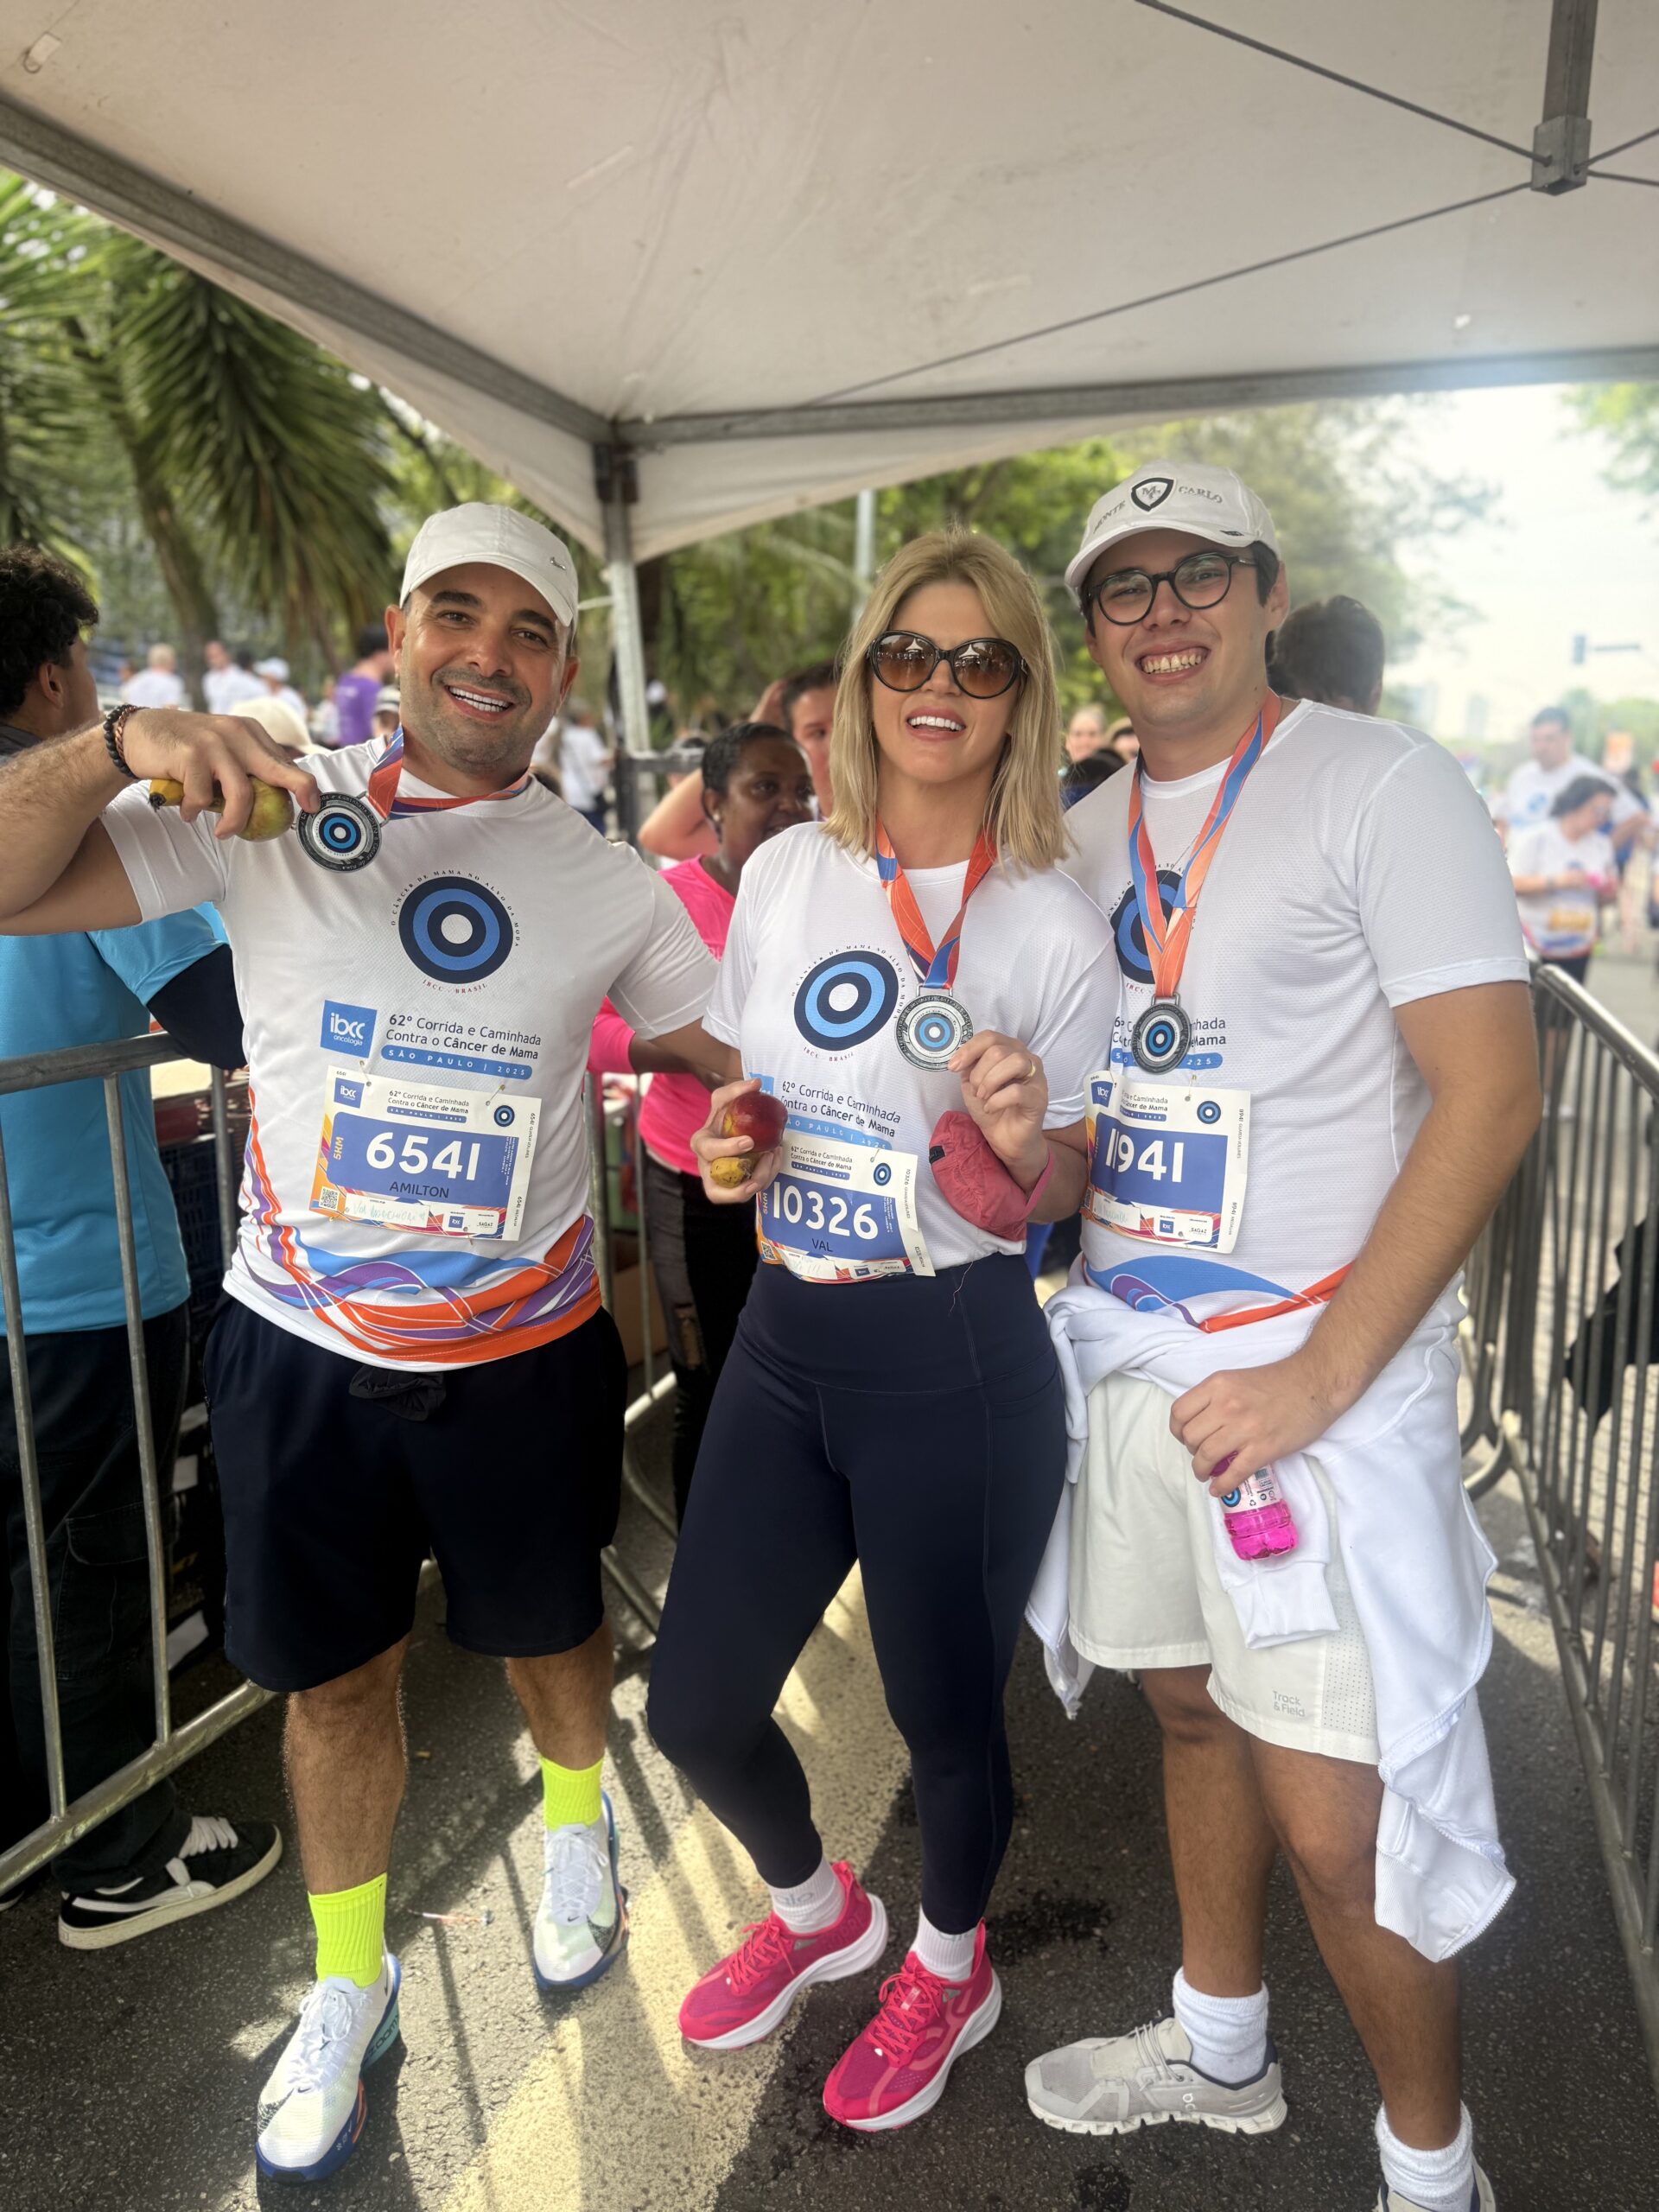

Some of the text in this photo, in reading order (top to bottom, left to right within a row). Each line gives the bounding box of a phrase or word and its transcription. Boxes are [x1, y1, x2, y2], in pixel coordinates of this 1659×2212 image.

[1179, 486, 1223, 504] CARLO
[467, 873, 480, 881] NO
[485, 881, 505, 902] ALVO
[507, 906, 515, 917] DA
[422, 979, 488, 994] IBCC BRASIL
[330, 1012, 365, 1040] ibcc
[416, 1017, 463, 1035] Corrida
[467, 1027, 476, 1036] e
[480, 1026, 542, 1046] Caminhada
[334, 1034, 363, 1046] oncologia
[385, 1029, 539, 1060] Contra o Câncer de Mama
[388, 1048, 416, 1059] SÃO
[427, 1055, 474, 1068] PAULO
[497, 1065, 526, 1077] 2025
[388, 1097, 409, 1106] Contra
[416, 1102, 439, 1110] Câncer
[403, 1092, 427, 1102] Corrida
[435, 1096, 469, 1107] Caminhada
[799, 1084, 834, 1103] Corrida
[836, 1095, 844, 1105] e
[847, 1096, 901, 1124] Caminhada
[1134, 1094, 1168, 1104] Caminhada
[809, 1122, 844, 1135] PAULO
[810, 1104, 817, 1114] o
[820, 1104, 854, 1122] Câncer
[855, 1115, 865, 1127] de
[868, 1119, 895, 1138] Mama
[333, 1136, 345, 1160] 5KM
[366, 1132, 481, 1181] 6541
[791, 1153, 805, 1161] Contra
[800, 1147, 817, 1157] Corrida
[823, 1152, 853, 1163] Caminhada
[389, 1181, 450, 1198] AMILTON
[773, 1181, 879, 1240] 10326
[811, 1238, 834, 1253] VAL
[1272, 1690, 1301, 1706] Track
[1274, 1700, 1306, 1718] & Field
